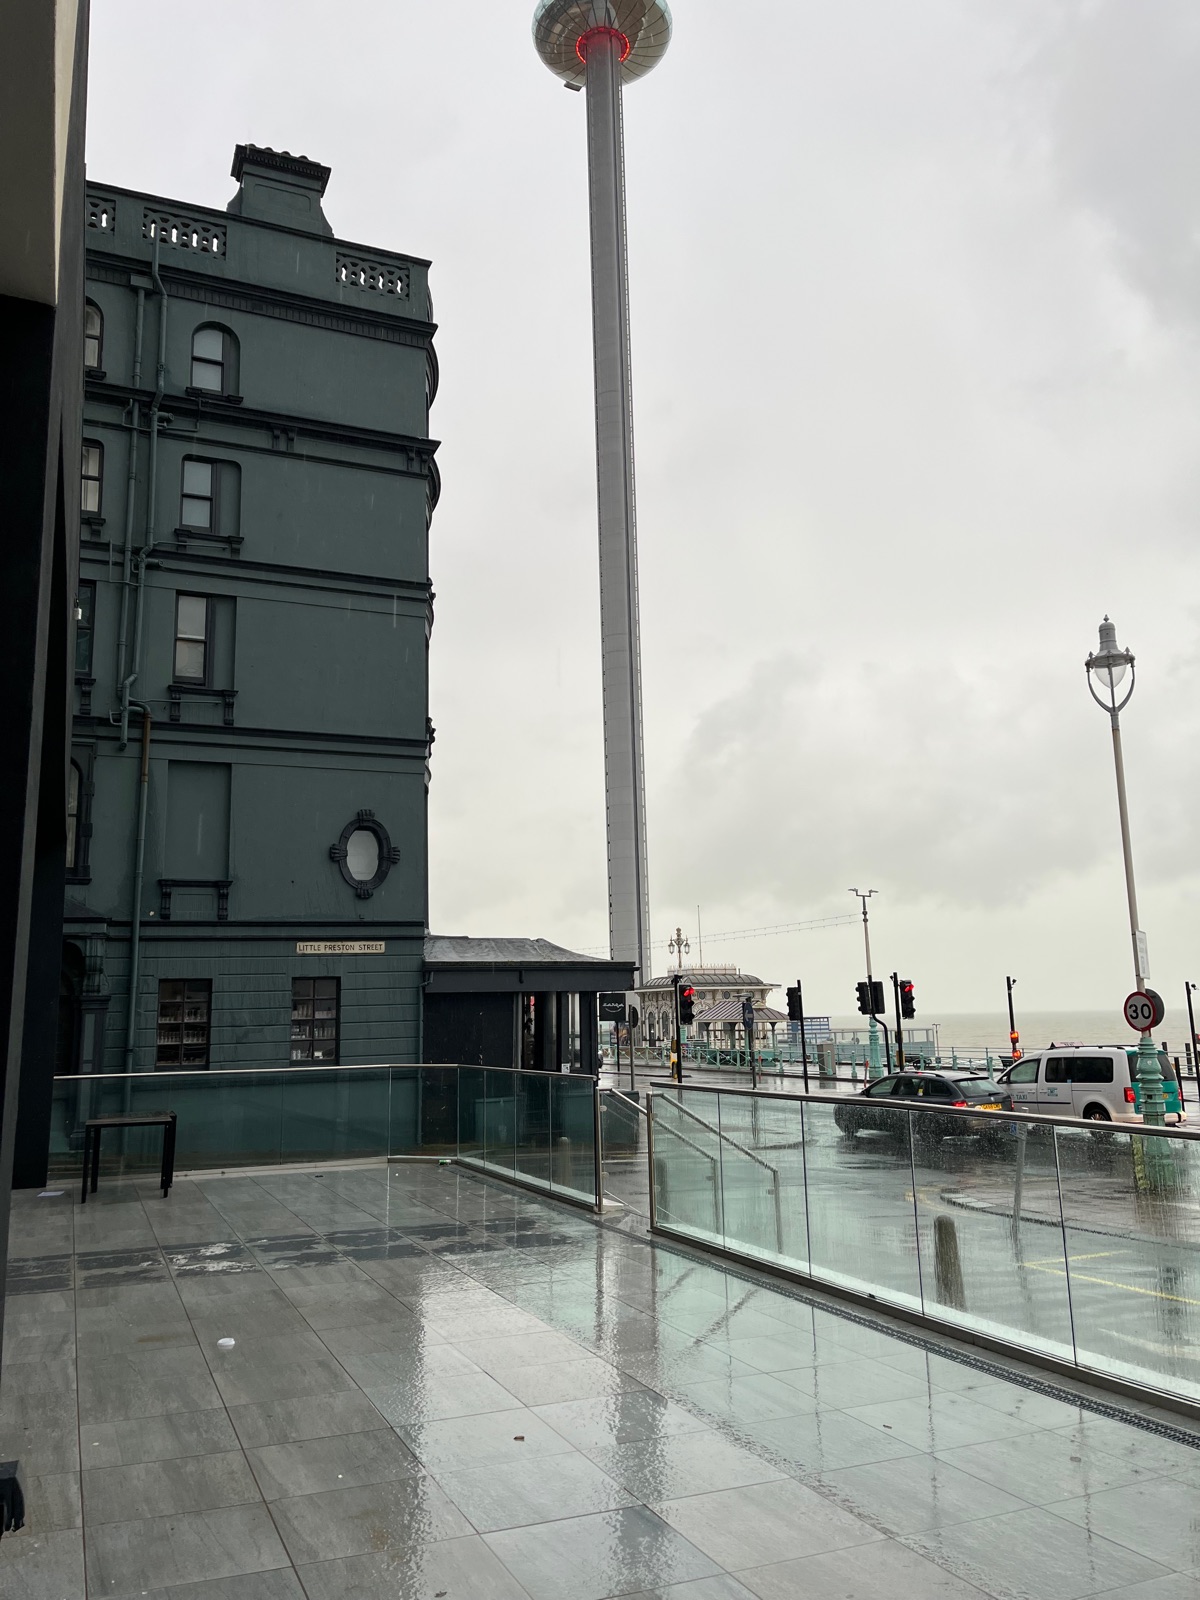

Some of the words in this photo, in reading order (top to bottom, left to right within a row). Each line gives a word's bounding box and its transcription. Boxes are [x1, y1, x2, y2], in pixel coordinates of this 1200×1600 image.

[298, 944, 321, 952] LITTLE
[358, 943, 383, 951] STREET
[1128, 1003, 1152, 1020] 30
